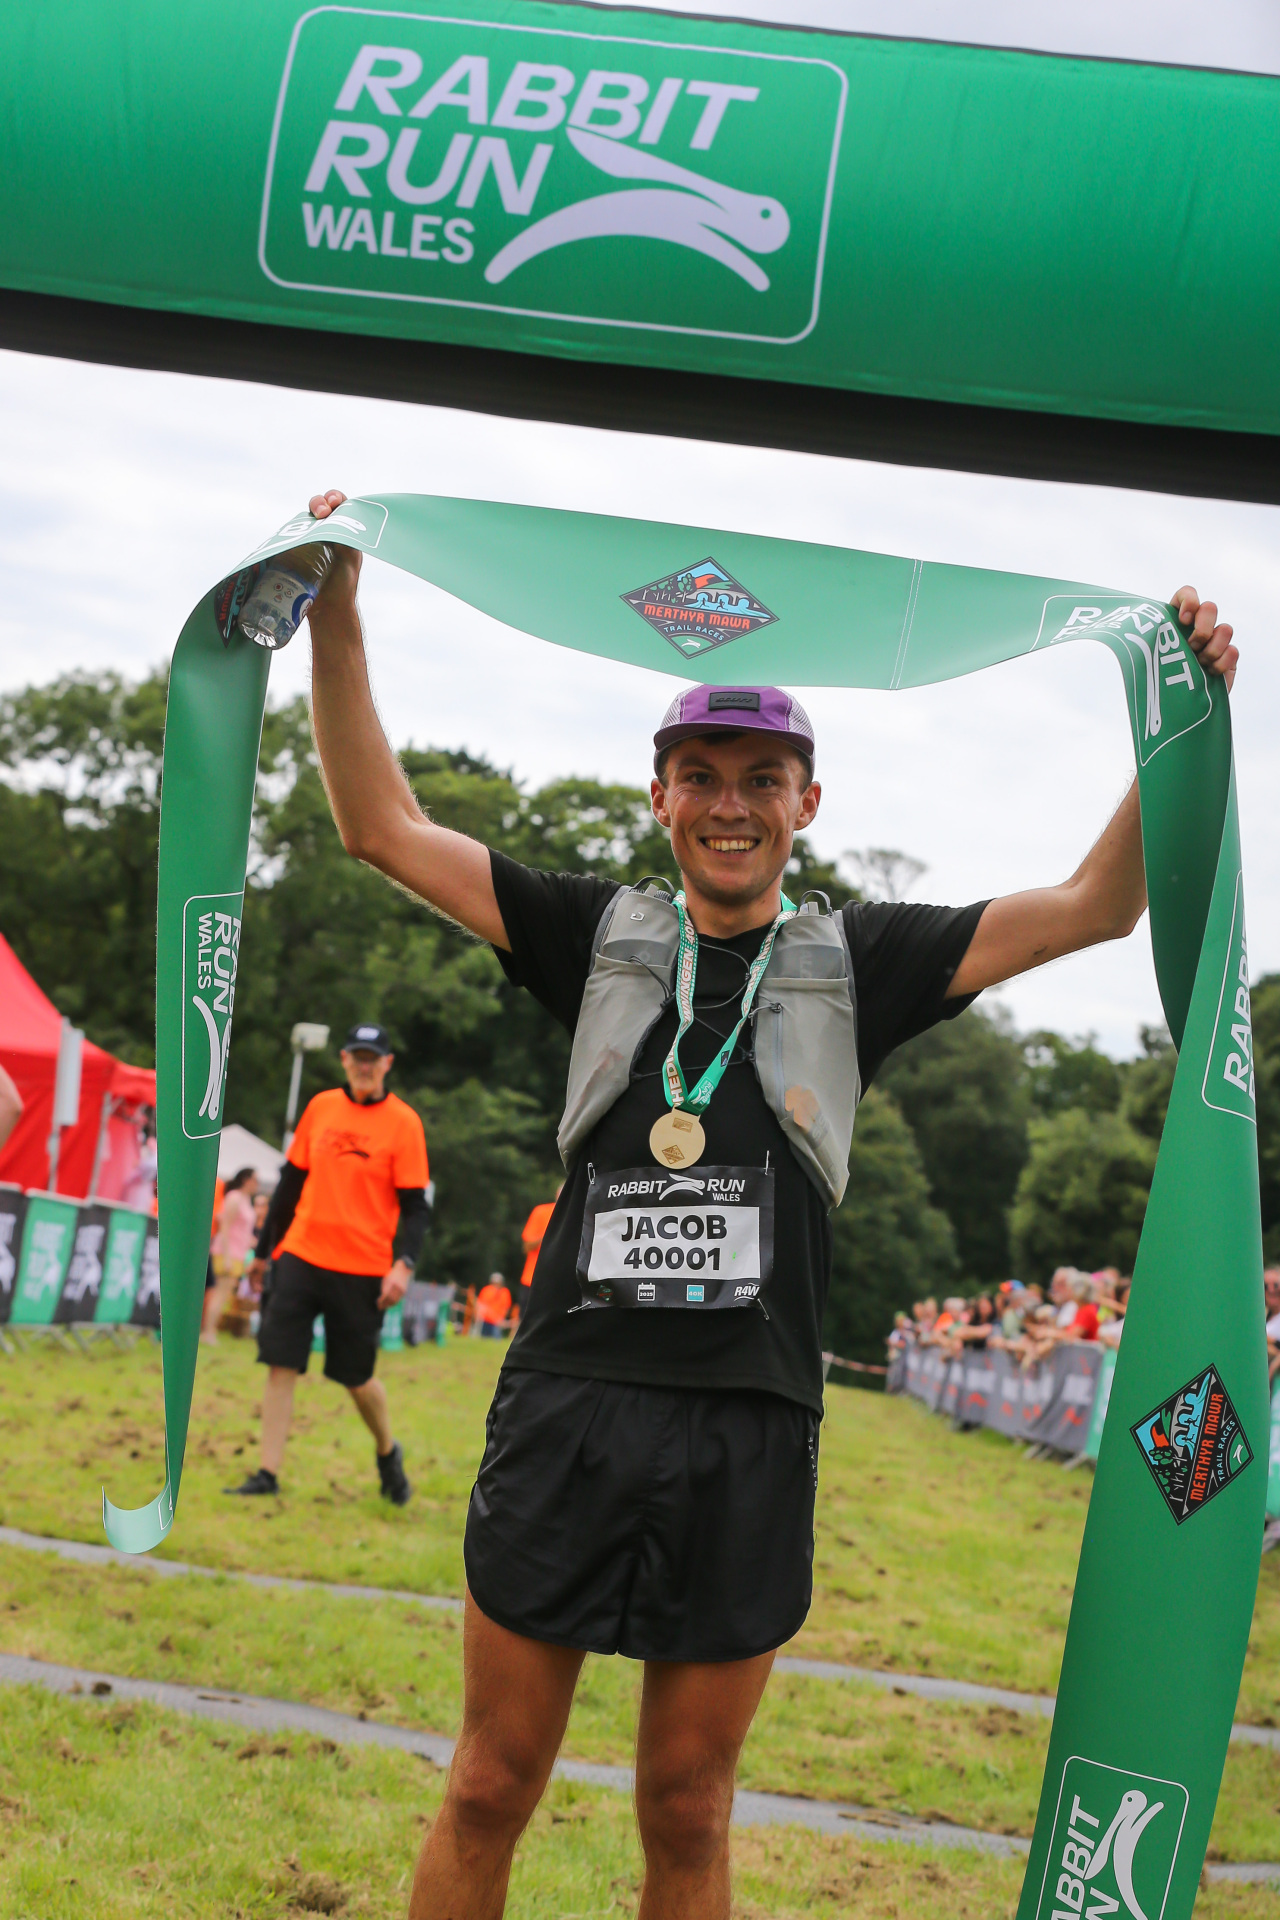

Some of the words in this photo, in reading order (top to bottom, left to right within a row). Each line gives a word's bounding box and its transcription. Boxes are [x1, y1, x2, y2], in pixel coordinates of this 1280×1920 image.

[334, 44, 760, 150] RABBIT
[303, 119, 554, 216] RUN
[302, 202, 475, 264] WALES
[644, 604, 705, 623] MERTHYR
[709, 613, 751, 630] MAWR
[664, 624, 692, 633] TRAIL
[695, 625, 724, 641] RACES
[198, 912, 213, 990] WALES
[213, 911, 232, 1014] RUN
[607, 1179, 668, 1198] RABBIT
[706, 1178, 746, 1193] RUN
[712, 1192, 741, 1202] WALES
[621, 1214, 727, 1242] JACOB
[623, 1246, 721, 1271] 40001
[734, 1285, 760, 1297] R4W
[1190, 1440, 1214, 1501] MERTHYR
[1204, 1393, 1224, 1436] MAWR
[1218, 1420, 1236, 1451] RACES
[1217, 1452, 1225, 1482] TRAIL
